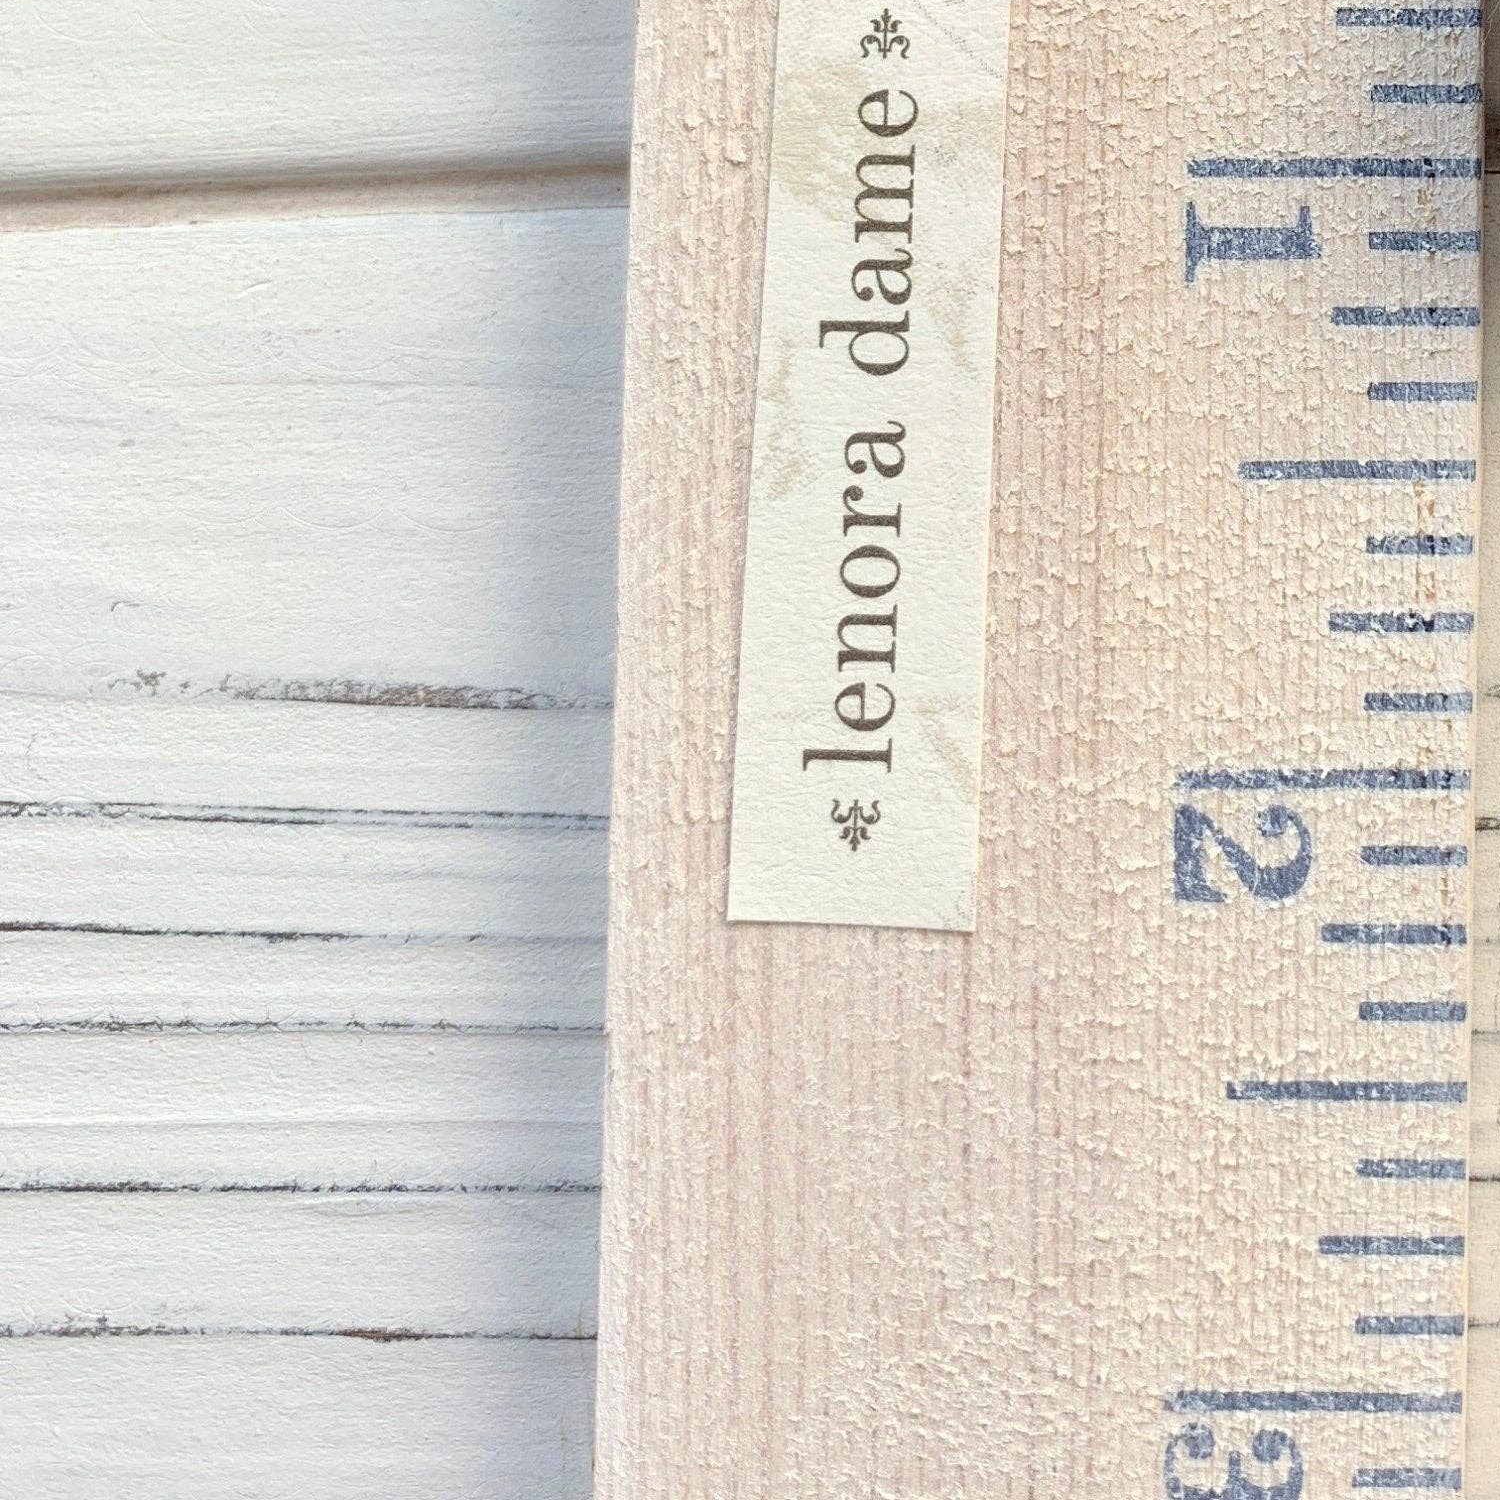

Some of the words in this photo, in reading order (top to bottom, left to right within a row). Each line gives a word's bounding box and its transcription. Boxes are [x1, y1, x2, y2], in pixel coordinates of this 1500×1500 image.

[819, 87, 920, 377] dame
[803, 419, 905, 773] lenora
[1172, 804, 1313, 904] 2
[1164, 1423, 1305, 1500] 3
